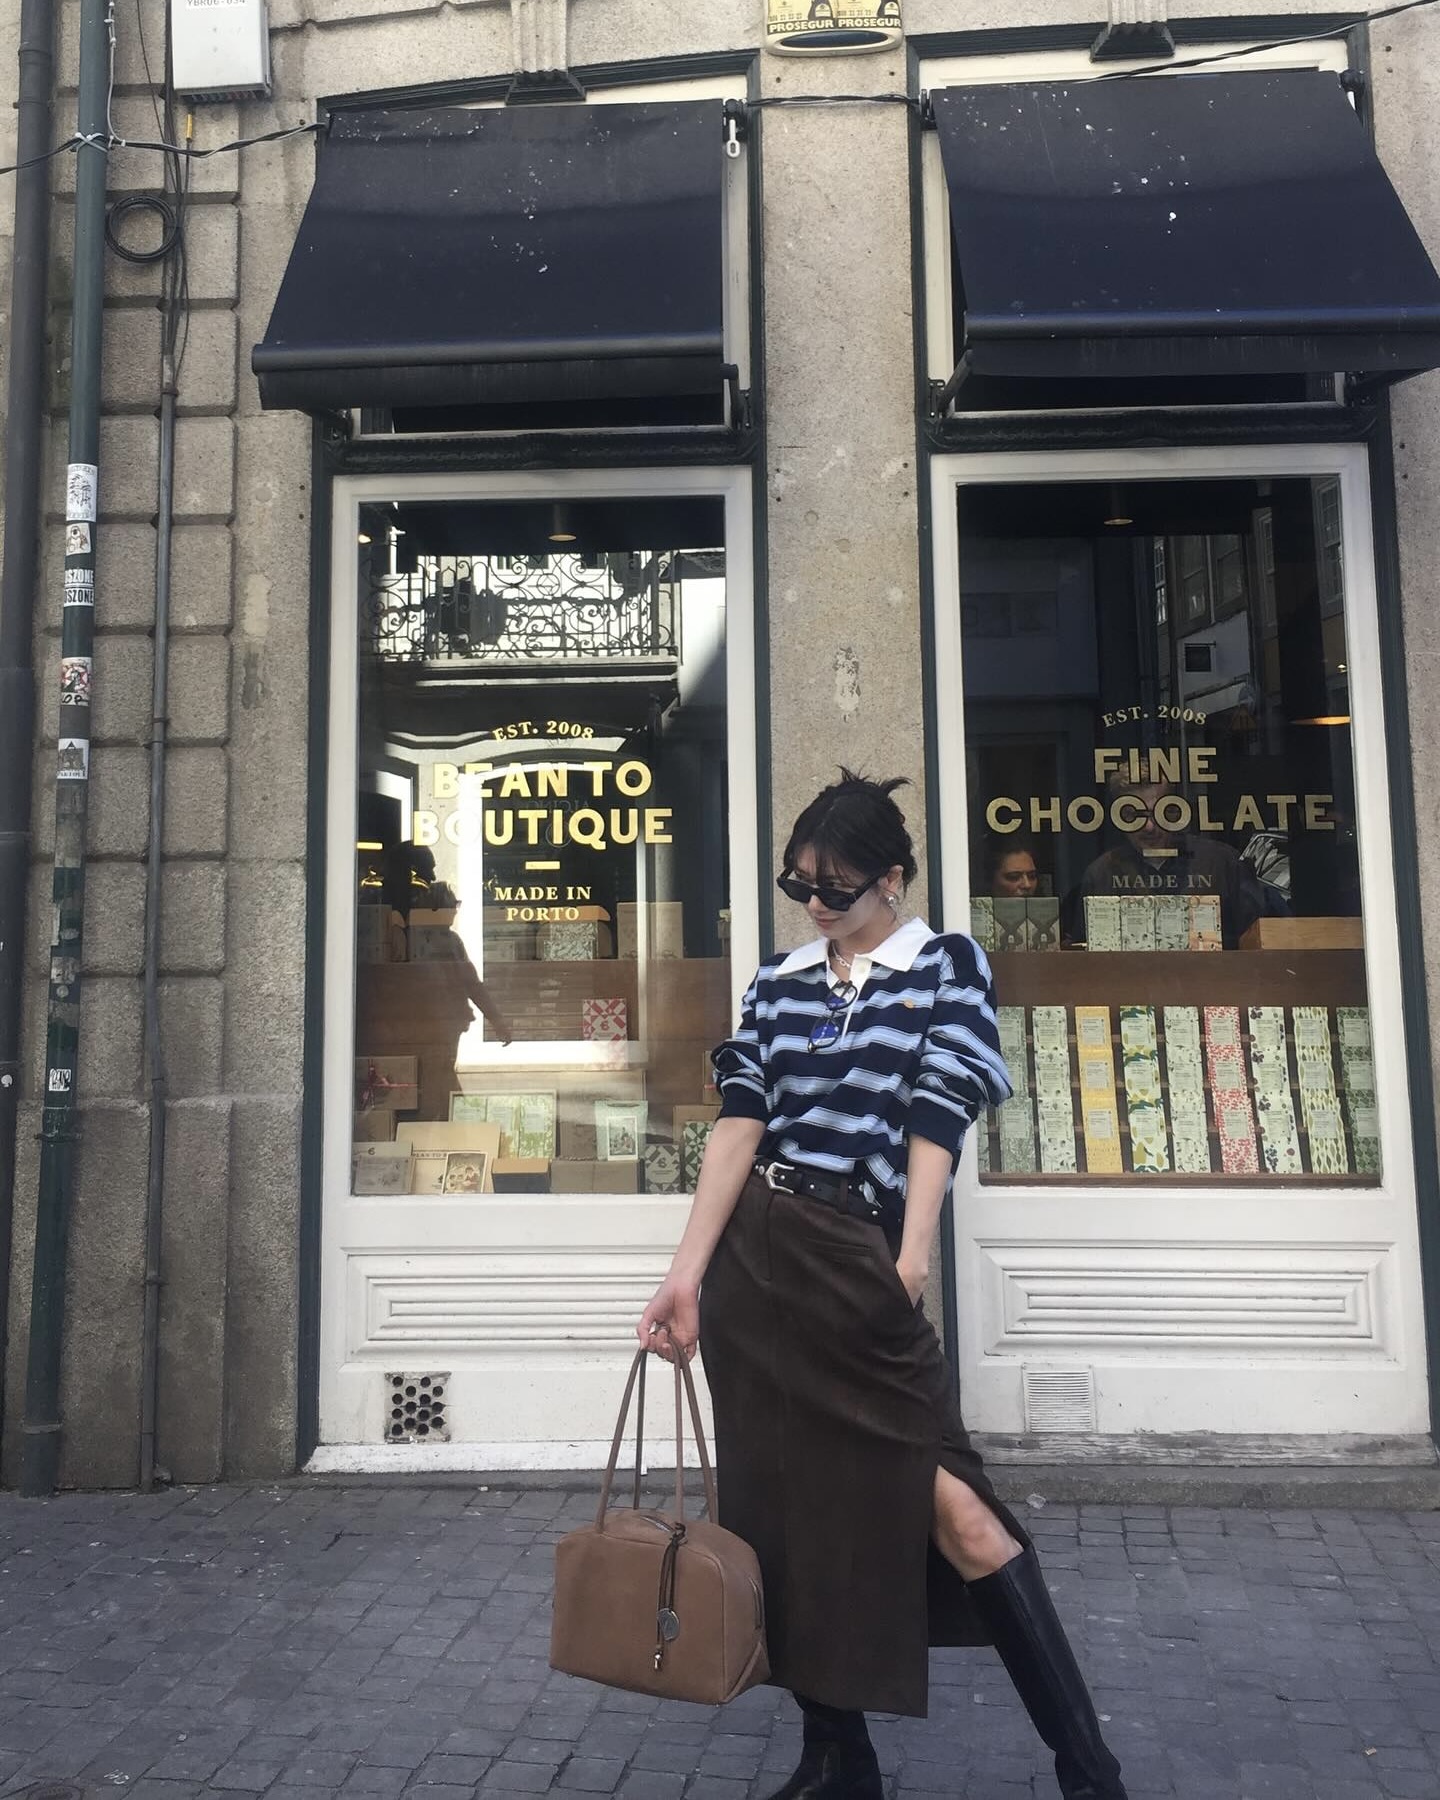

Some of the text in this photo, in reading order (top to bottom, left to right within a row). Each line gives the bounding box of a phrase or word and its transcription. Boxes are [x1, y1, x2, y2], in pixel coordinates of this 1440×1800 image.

[769, 20, 834, 33] PROSEGUR
[838, 18, 901, 28] PROSEGUR
[1102, 705, 1207, 728] EST. 2008
[492, 720, 594, 743] EST. 2008
[1094, 747, 1218, 783] FINE
[433, 761, 652, 798] BEAN TO
[985, 795, 1335, 833] CHOCOLATE
[413, 808, 673, 850] BOUTIQUE
[1112, 875, 1212, 888] MADE IN
[494, 886, 592, 901] MADE IN
[507, 907, 580, 921] PORTO
